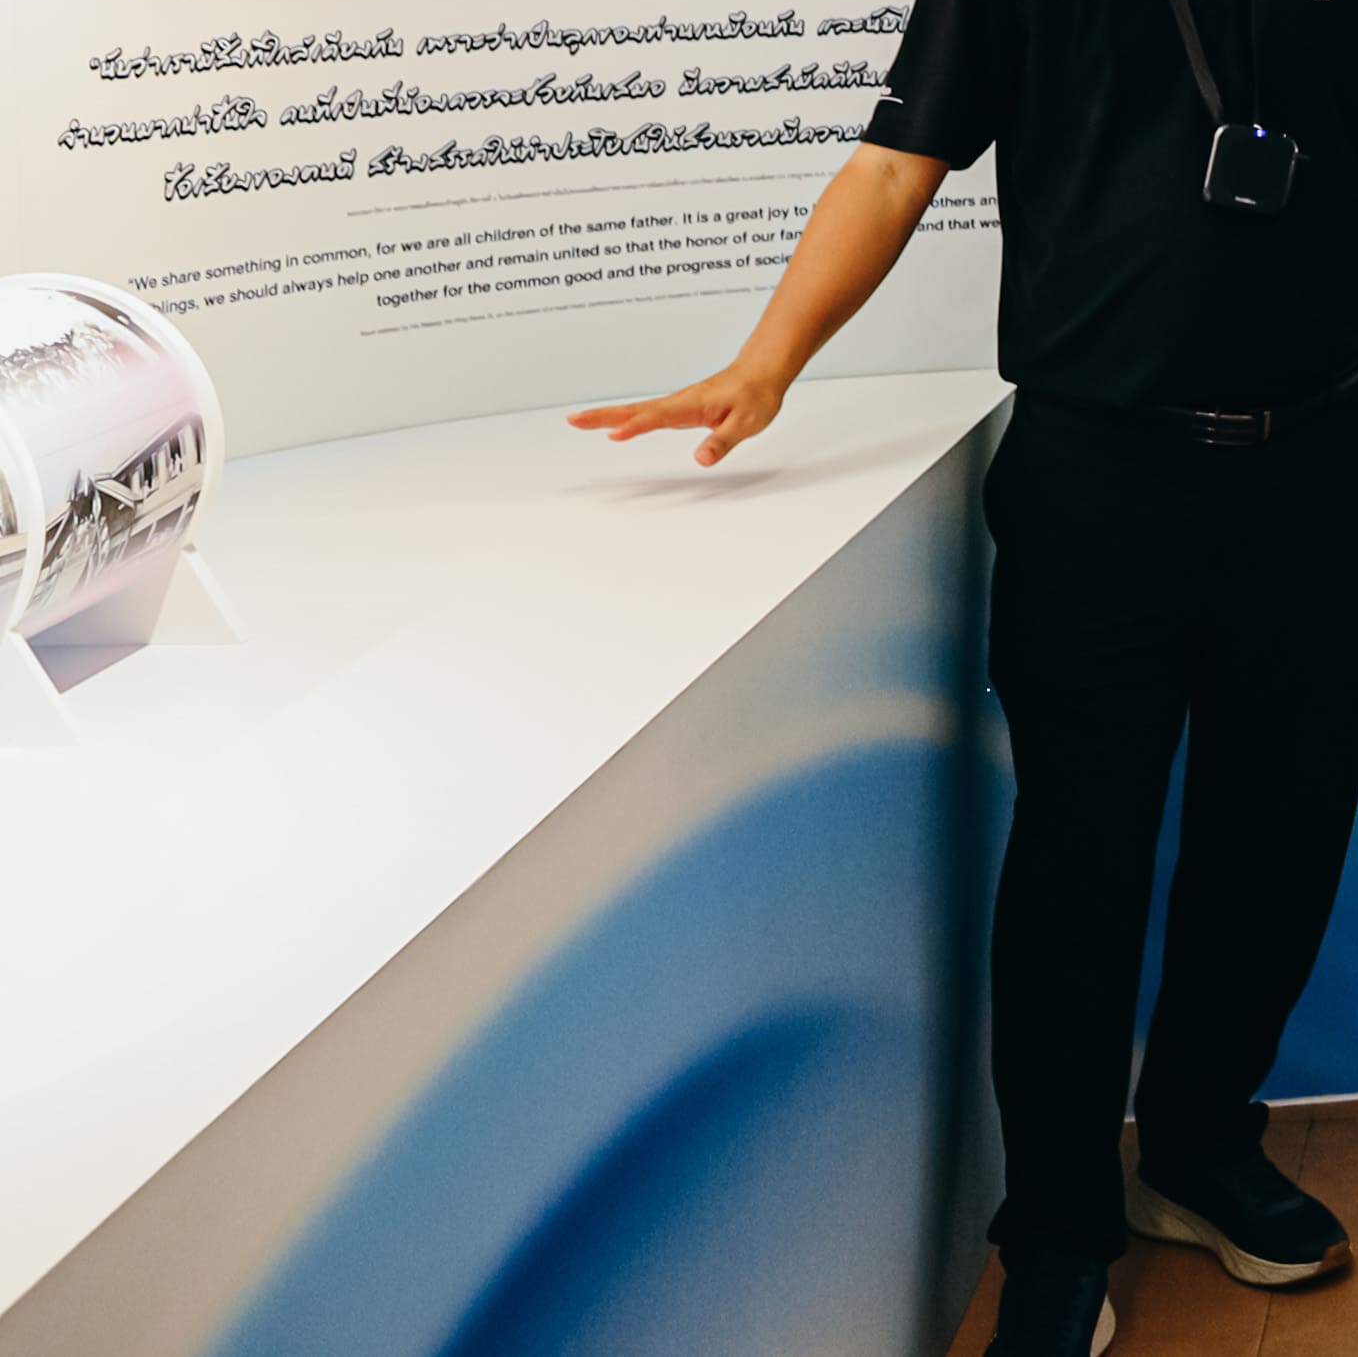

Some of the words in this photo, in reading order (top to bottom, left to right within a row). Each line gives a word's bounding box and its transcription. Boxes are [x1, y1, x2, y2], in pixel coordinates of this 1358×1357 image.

[161, 270, 202, 287] share
[204, 257, 282, 280] something
[285, 254, 300, 268] in
[302, 247, 372, 266] common,
[375, 241, 397, 256] for
[400, 240, 423, 253] we
[426, 237, 451, 250] are
[453, 232, 472, 247] all
[474, 227, 536, 245] children
[538, 222, 555, 238] of
[558, 222, 583, 236] the
[585, 220, 627, 234] same
[630, 214, 678, 229] father.
[682, 212, 693, 225] It
[696, 210, 710, 224] is
[712, 212, 723, 223] a
[725, 207, 764, 225] great
[767, 206, 790, 222] joy
[793, 205, 809, 217] to
[979, 196, 997, 207] an
[203, 294, 226, 307] we
[229, 282, 279, 304] should
[282, 277, 334, 295] always
[337, 270, 370, 287] help
[372, 268, 401, 282] one
[404, 260, 462, 278] another
[465, 254, 494, 271] and
[497, 249, 550, 267] remain
[552, 243, 600, 261] united
[603, 244, 622, 256] so
[625, 239, 655, 254] that
[658, 237, 683, 251] the
[685, 235, 729, 249] honor
[732, 230, 748, 245] of
[751, 232, 776, 244] our
[947, 218, 976, 231] that
[376, 288, 439, 309] together
[442, 284, 464, 299] for
[467, 281, 492, 295] the
[494, 274, 561, 292] common
[563, 267, 604, 288] good
[606, 265, 636, 281] and
[638, 263, 663, 277] the
[666, 259, 733, 277] progress
[735, 253, 751, 268] of
